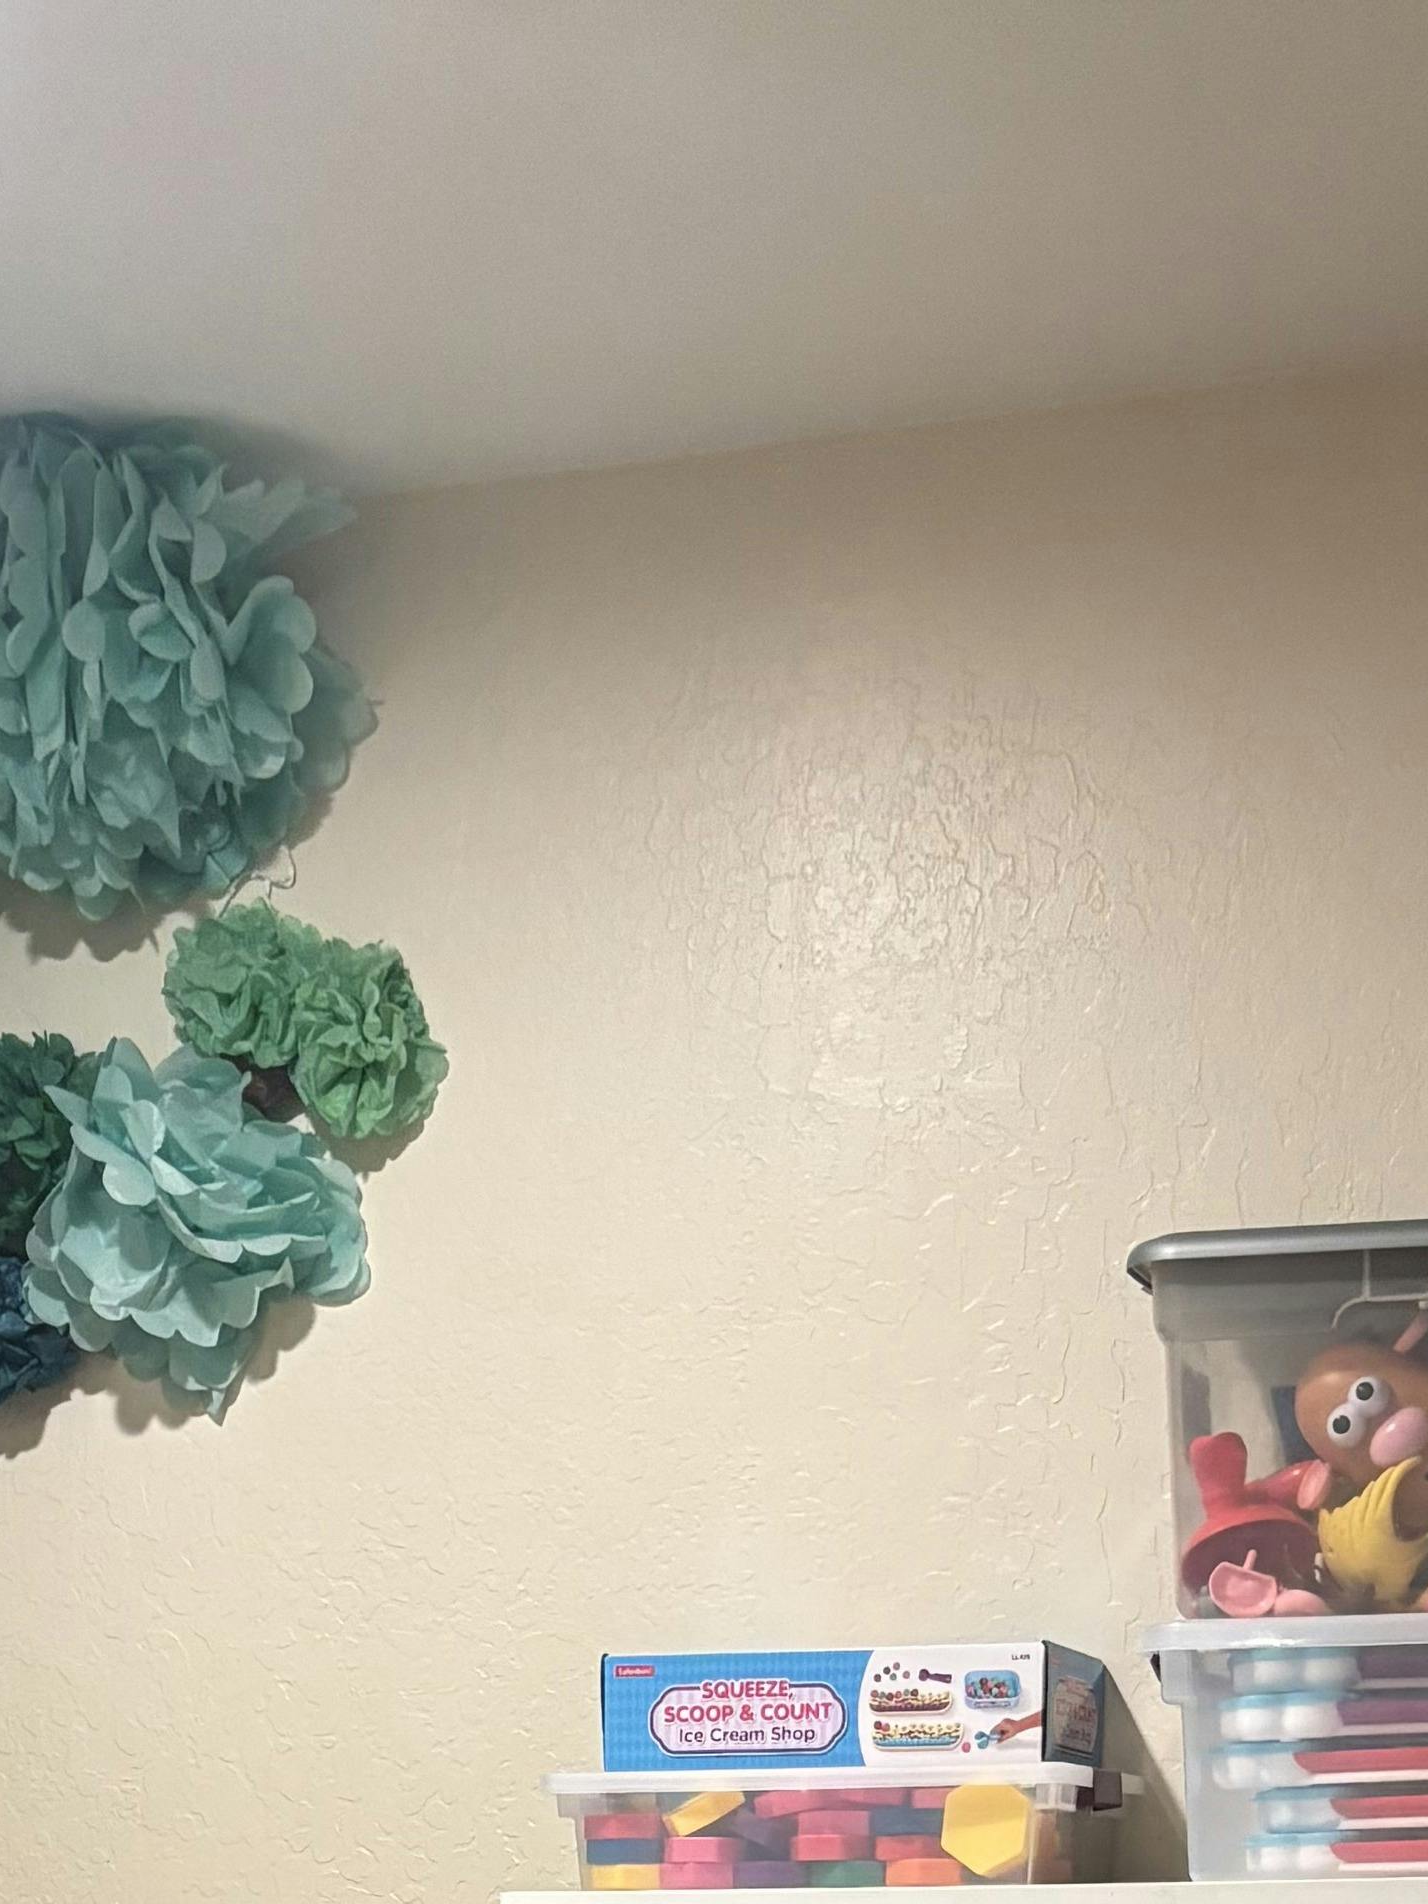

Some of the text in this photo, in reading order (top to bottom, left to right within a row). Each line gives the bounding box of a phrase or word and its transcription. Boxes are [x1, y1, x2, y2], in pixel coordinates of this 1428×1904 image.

[702, 1680, 793, 1700] SQUEEZE,
[664, 1702, 832, 1722] SCOOP & COUNT
[679, 1726, 815, 1743] Ice Cream Shop
